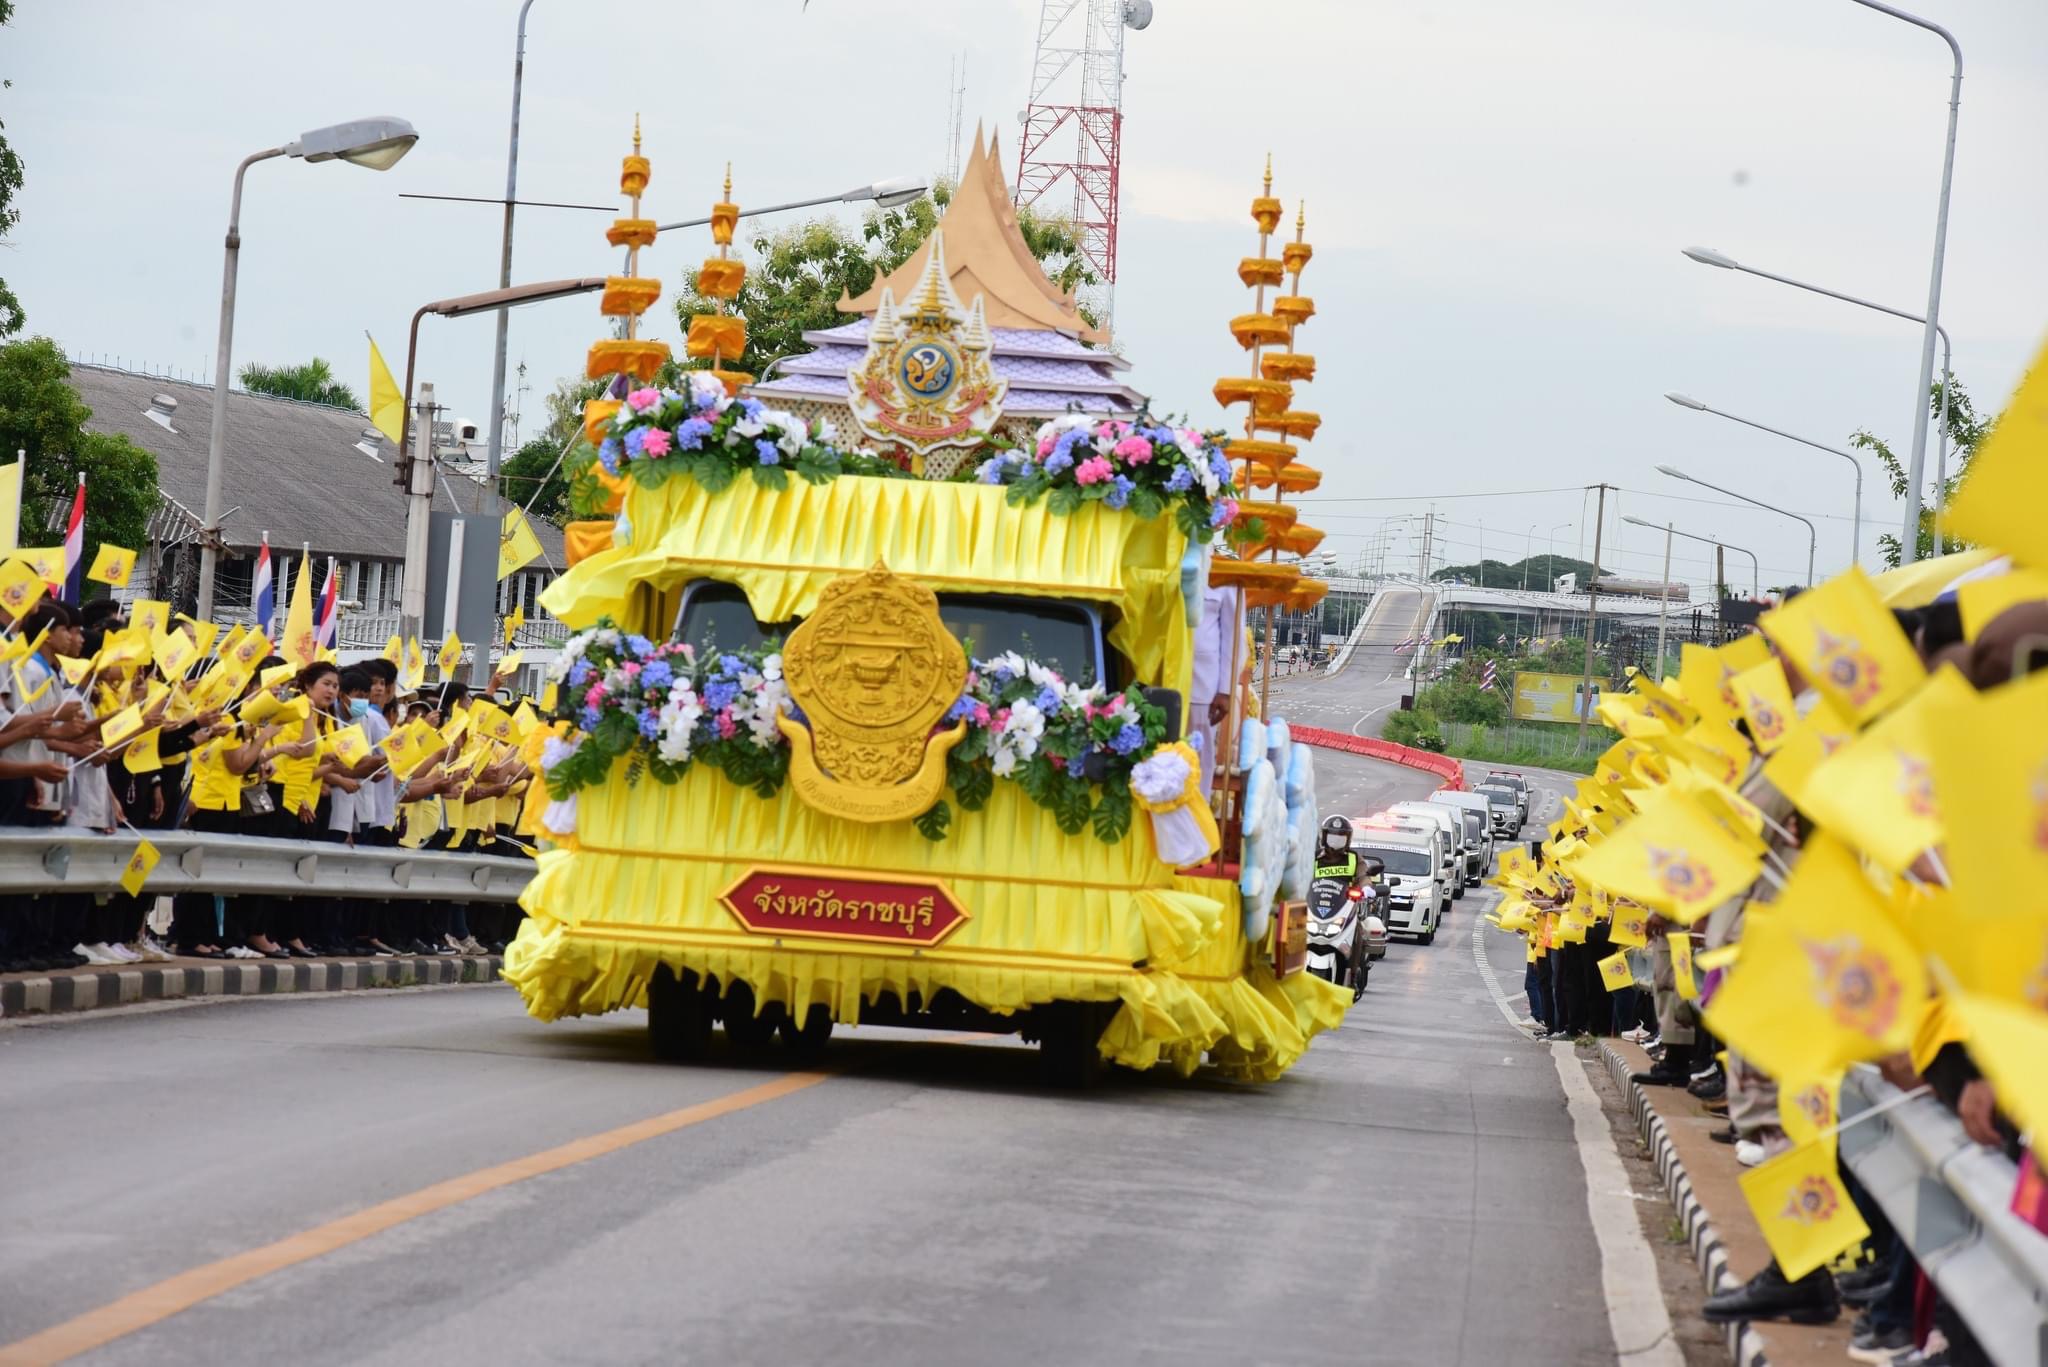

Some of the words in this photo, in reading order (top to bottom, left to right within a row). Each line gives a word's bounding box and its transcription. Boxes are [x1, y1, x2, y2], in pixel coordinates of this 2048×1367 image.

[1319, 867, 1349, 876] POLICE
[753, 884, 935, 935] จังหวัดราชบุรี
